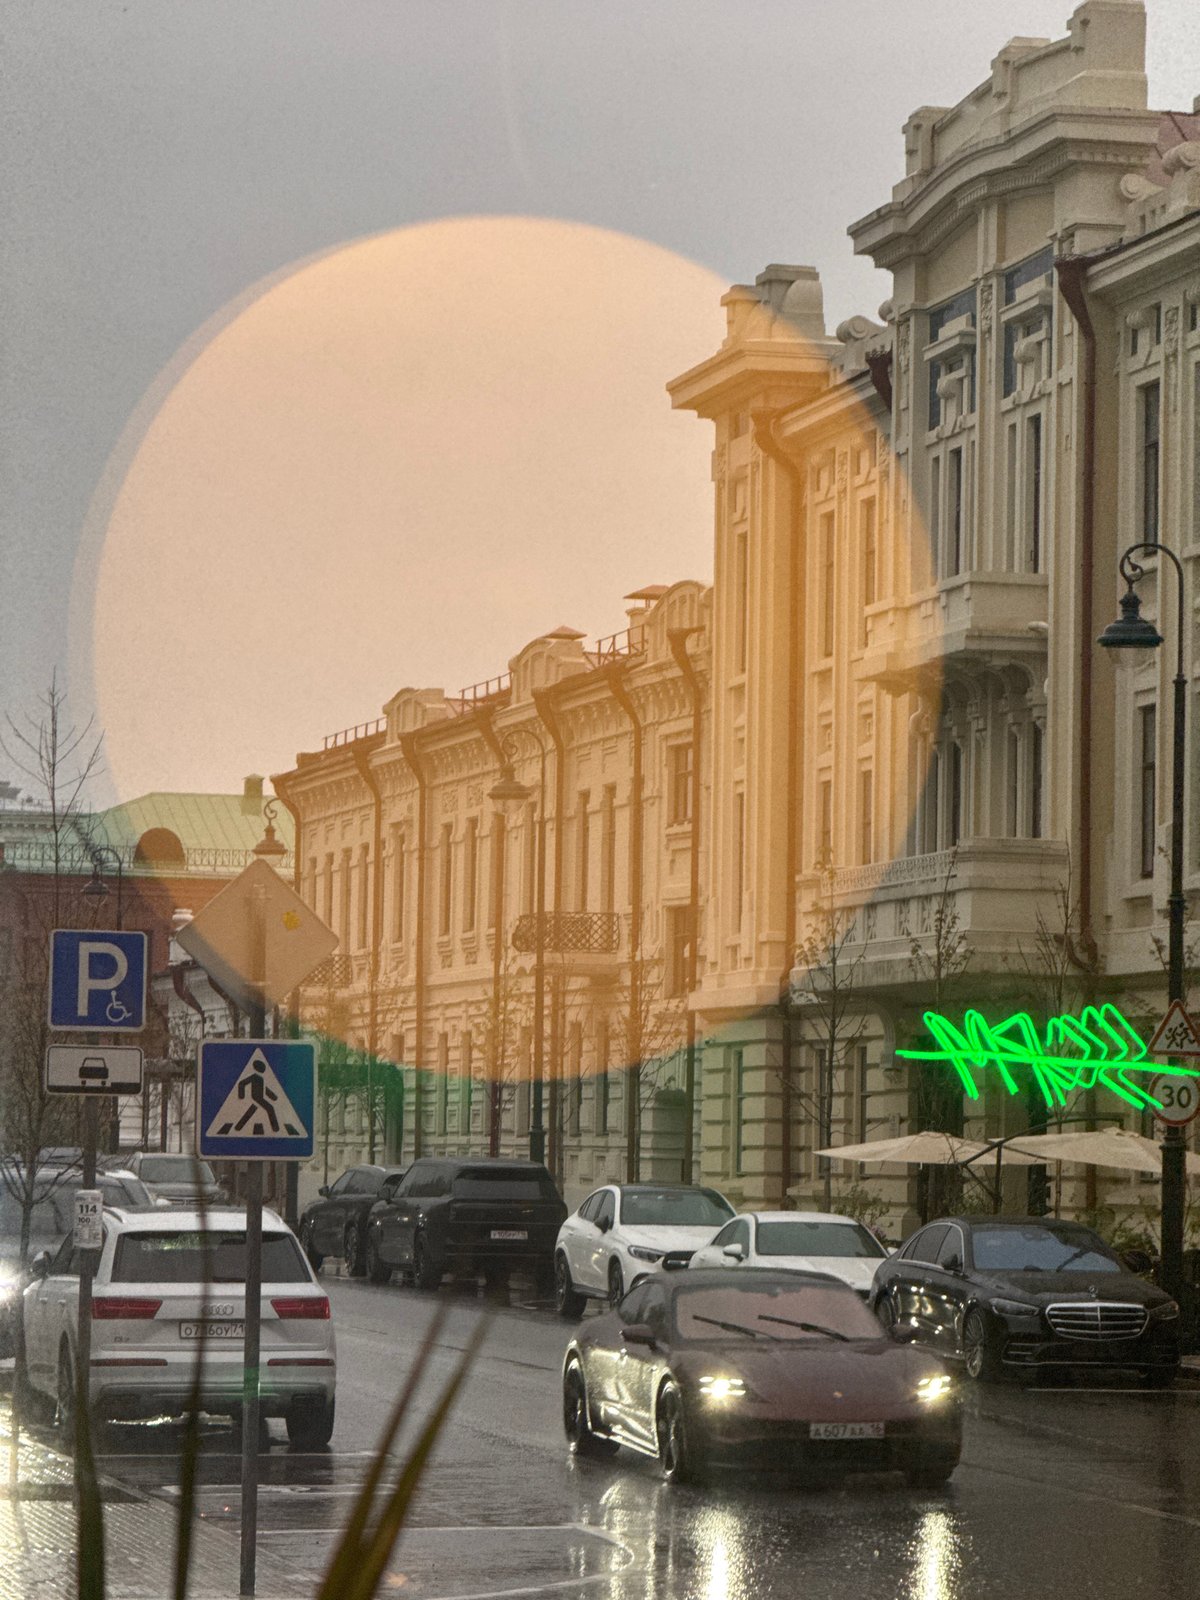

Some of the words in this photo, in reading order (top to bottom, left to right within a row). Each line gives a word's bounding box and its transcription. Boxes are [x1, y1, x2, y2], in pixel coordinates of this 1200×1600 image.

[78, 941, 128, 1017] P
[1161, 1085, 1192, 1108] 30
[79, 1204, 97, 1214] 114
